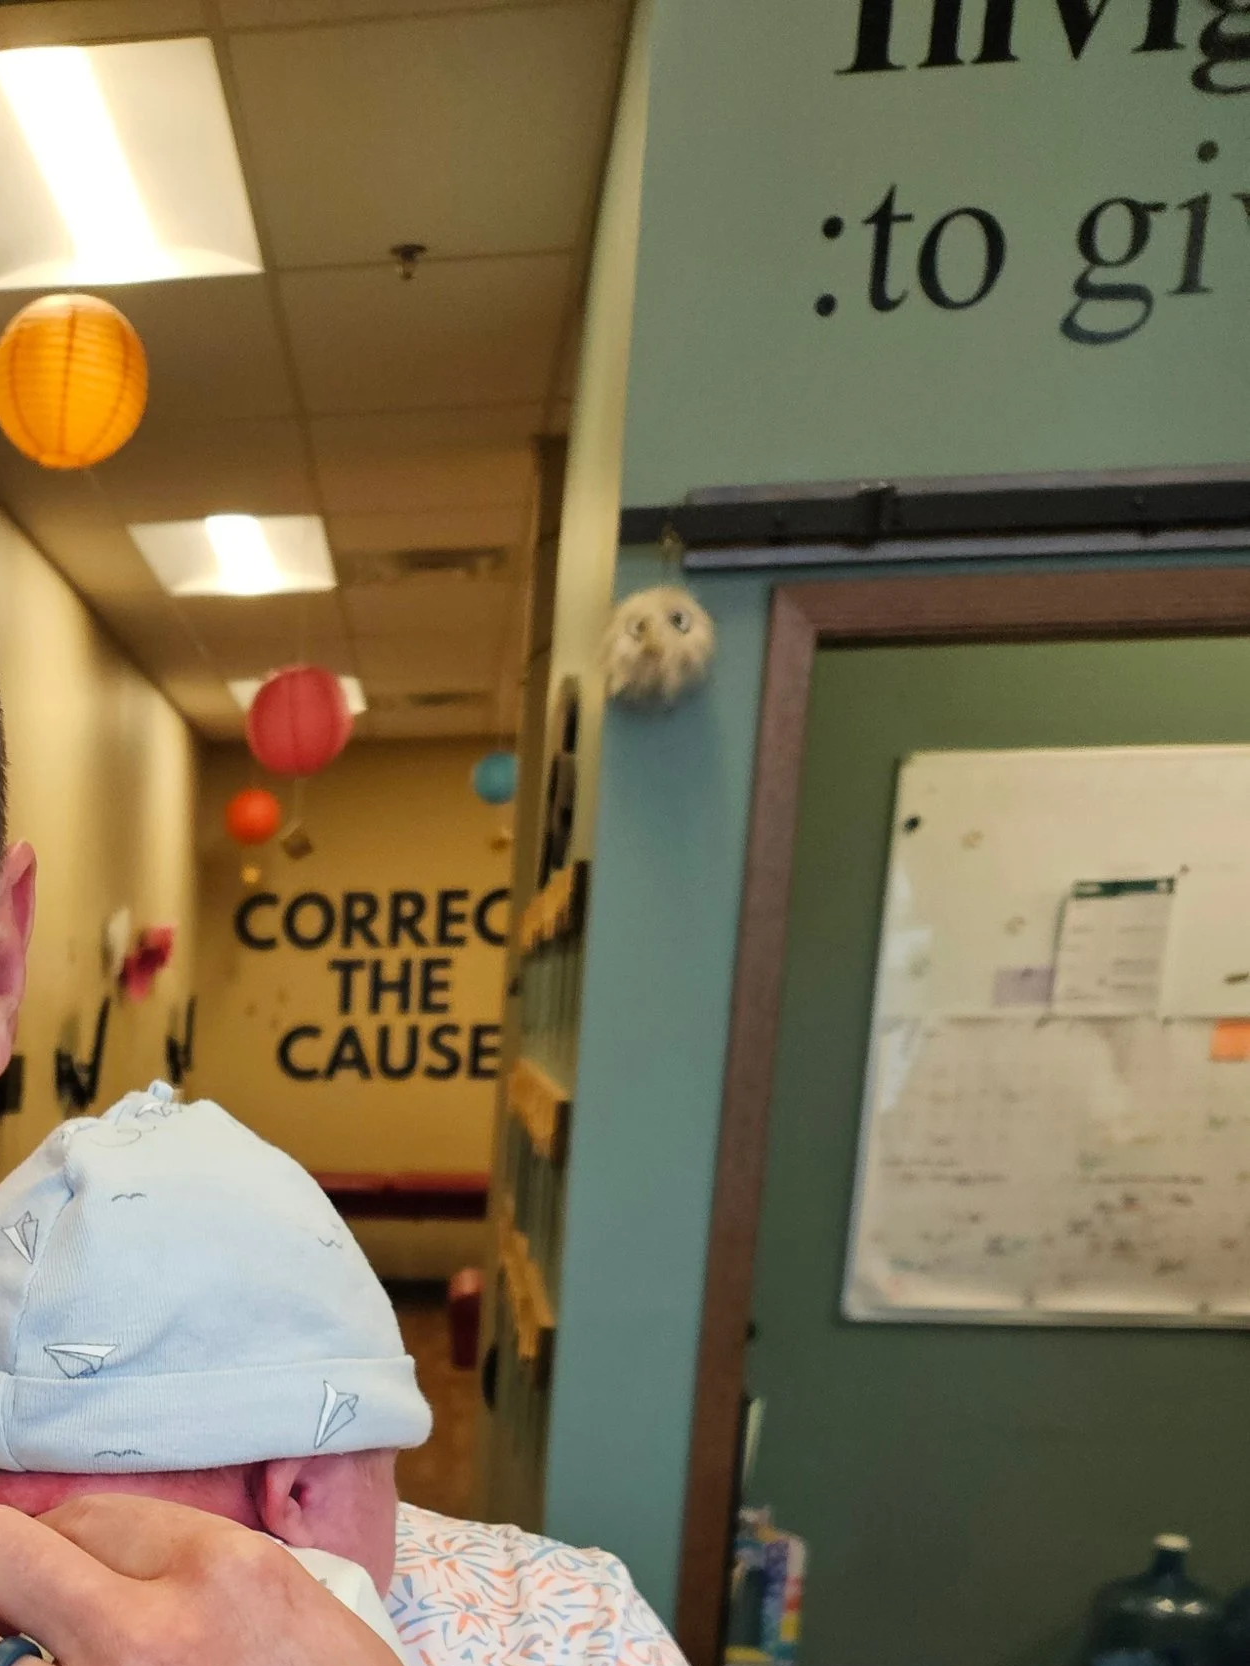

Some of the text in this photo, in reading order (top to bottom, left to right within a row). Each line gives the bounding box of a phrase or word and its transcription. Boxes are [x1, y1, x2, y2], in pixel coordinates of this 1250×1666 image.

[1060, 139, 1250, 346] gi
[234, 888, 511, 951] CORREC
[329, 957, 453, 1015] THE
[276, 1023, 502, 1082] CAUSE
